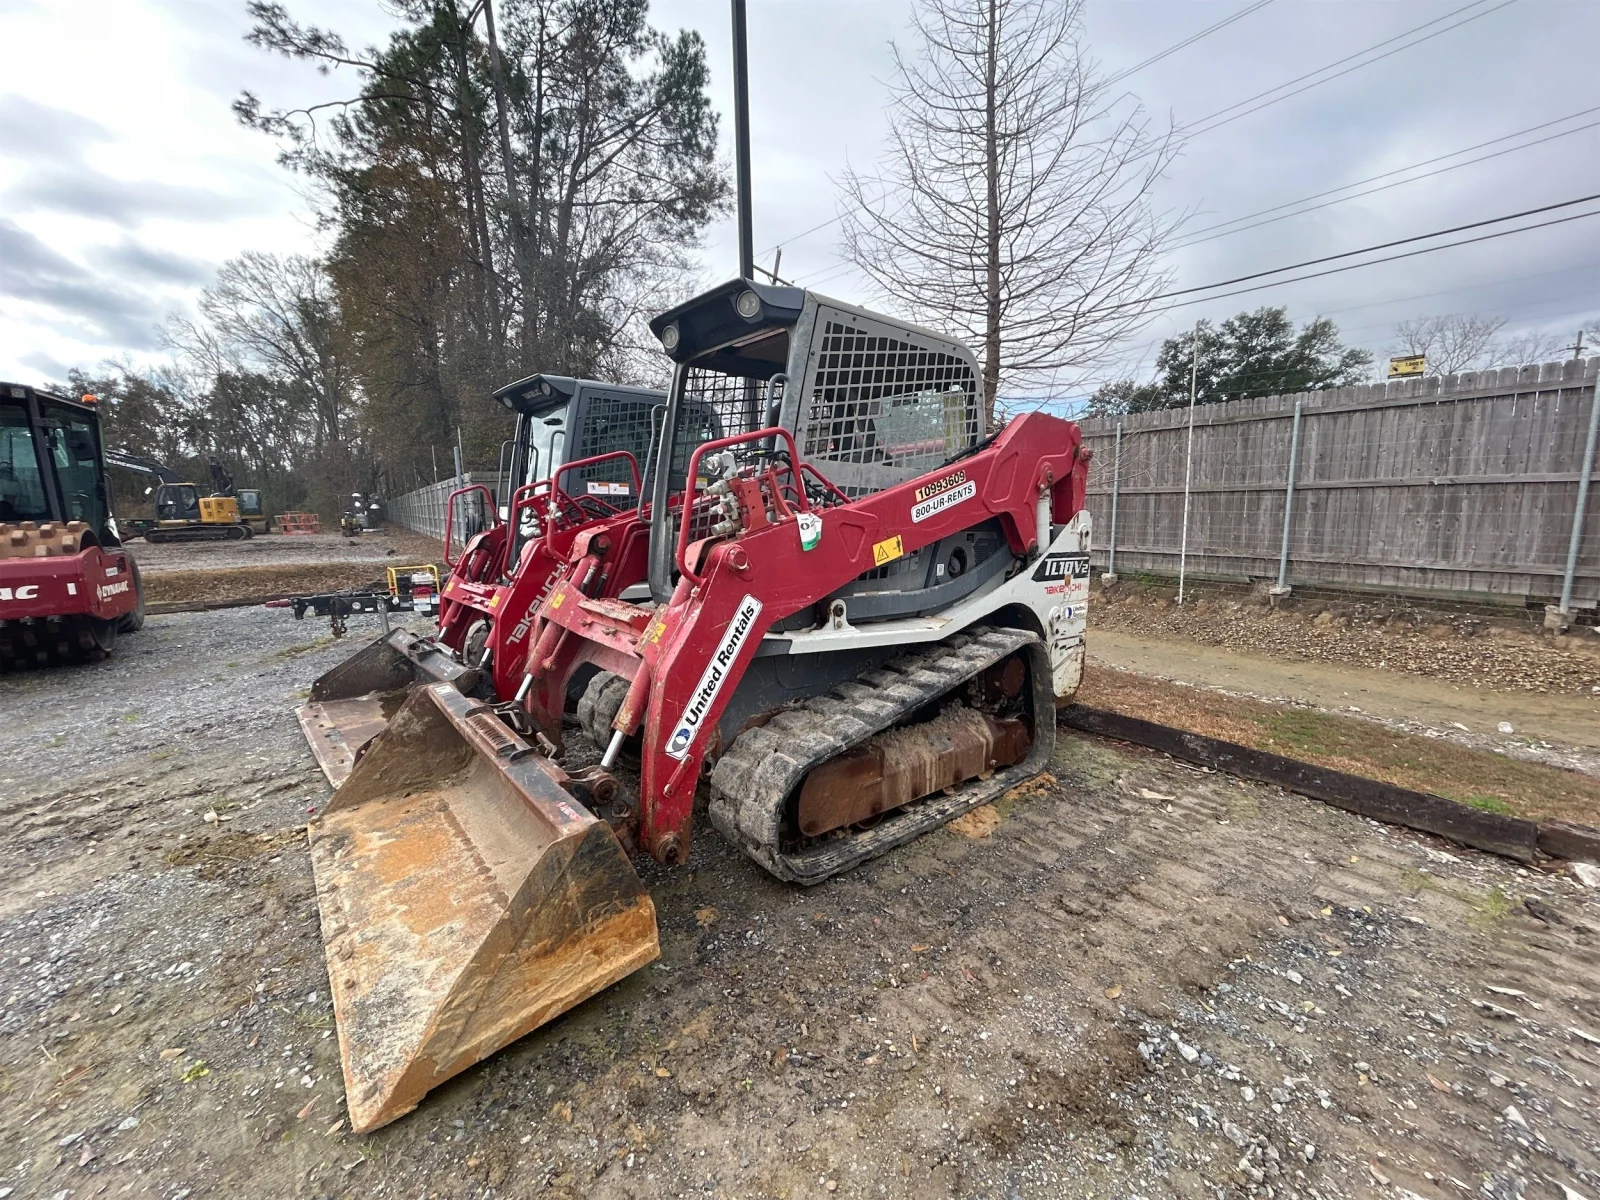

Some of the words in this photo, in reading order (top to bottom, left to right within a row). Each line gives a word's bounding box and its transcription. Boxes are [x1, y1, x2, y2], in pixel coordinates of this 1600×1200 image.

[918, 471, 965, 499] 10993609
[915, 485, 973, 518] 800-UR-RENTS
[1044, 556, 1090, 576] TL10V2
[1044, 583, 1082, 595] TAKECHI
[685, 666, 722, 726] United
[717, 604, 755, 667] Rentals
